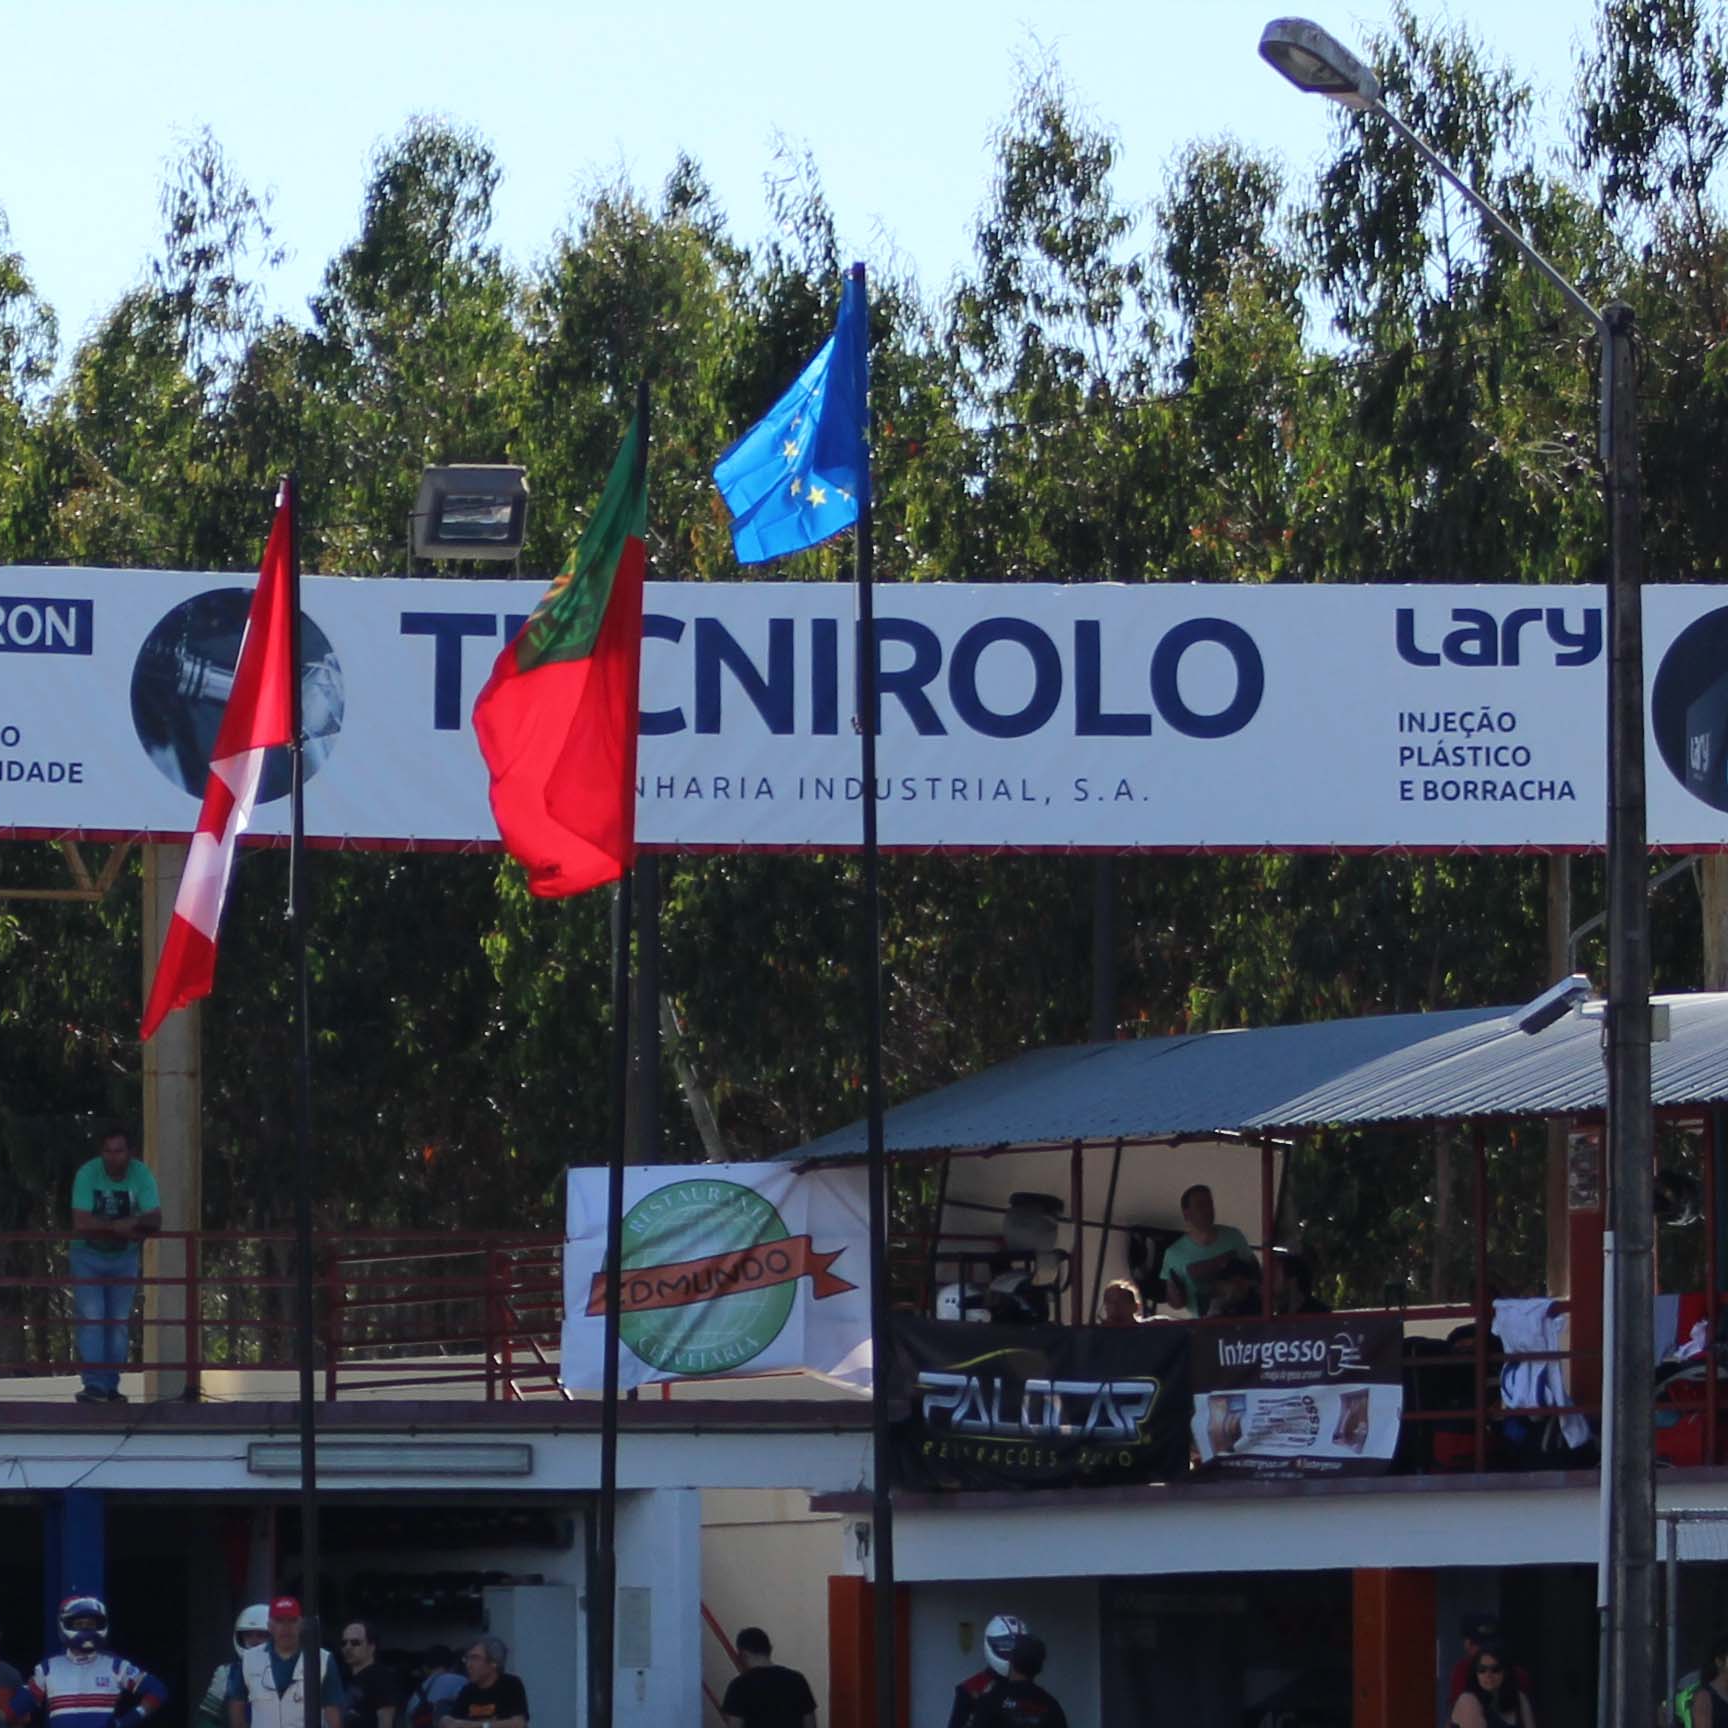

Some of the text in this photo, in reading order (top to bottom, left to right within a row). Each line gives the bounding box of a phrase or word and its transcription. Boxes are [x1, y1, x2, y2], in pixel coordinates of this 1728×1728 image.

[400, 611, 1265, 739] TCNIROLO
[1399, 706, 1517, 740] INJEÇÃO
[1399, 739, 1531, 768] PLÁSTICO
[1073, 778, 1150, 803] S.A.
[1400, 779, 1576, 802] E BORRACHA
[1218, 1338, 1327, 1369] Intergesso
